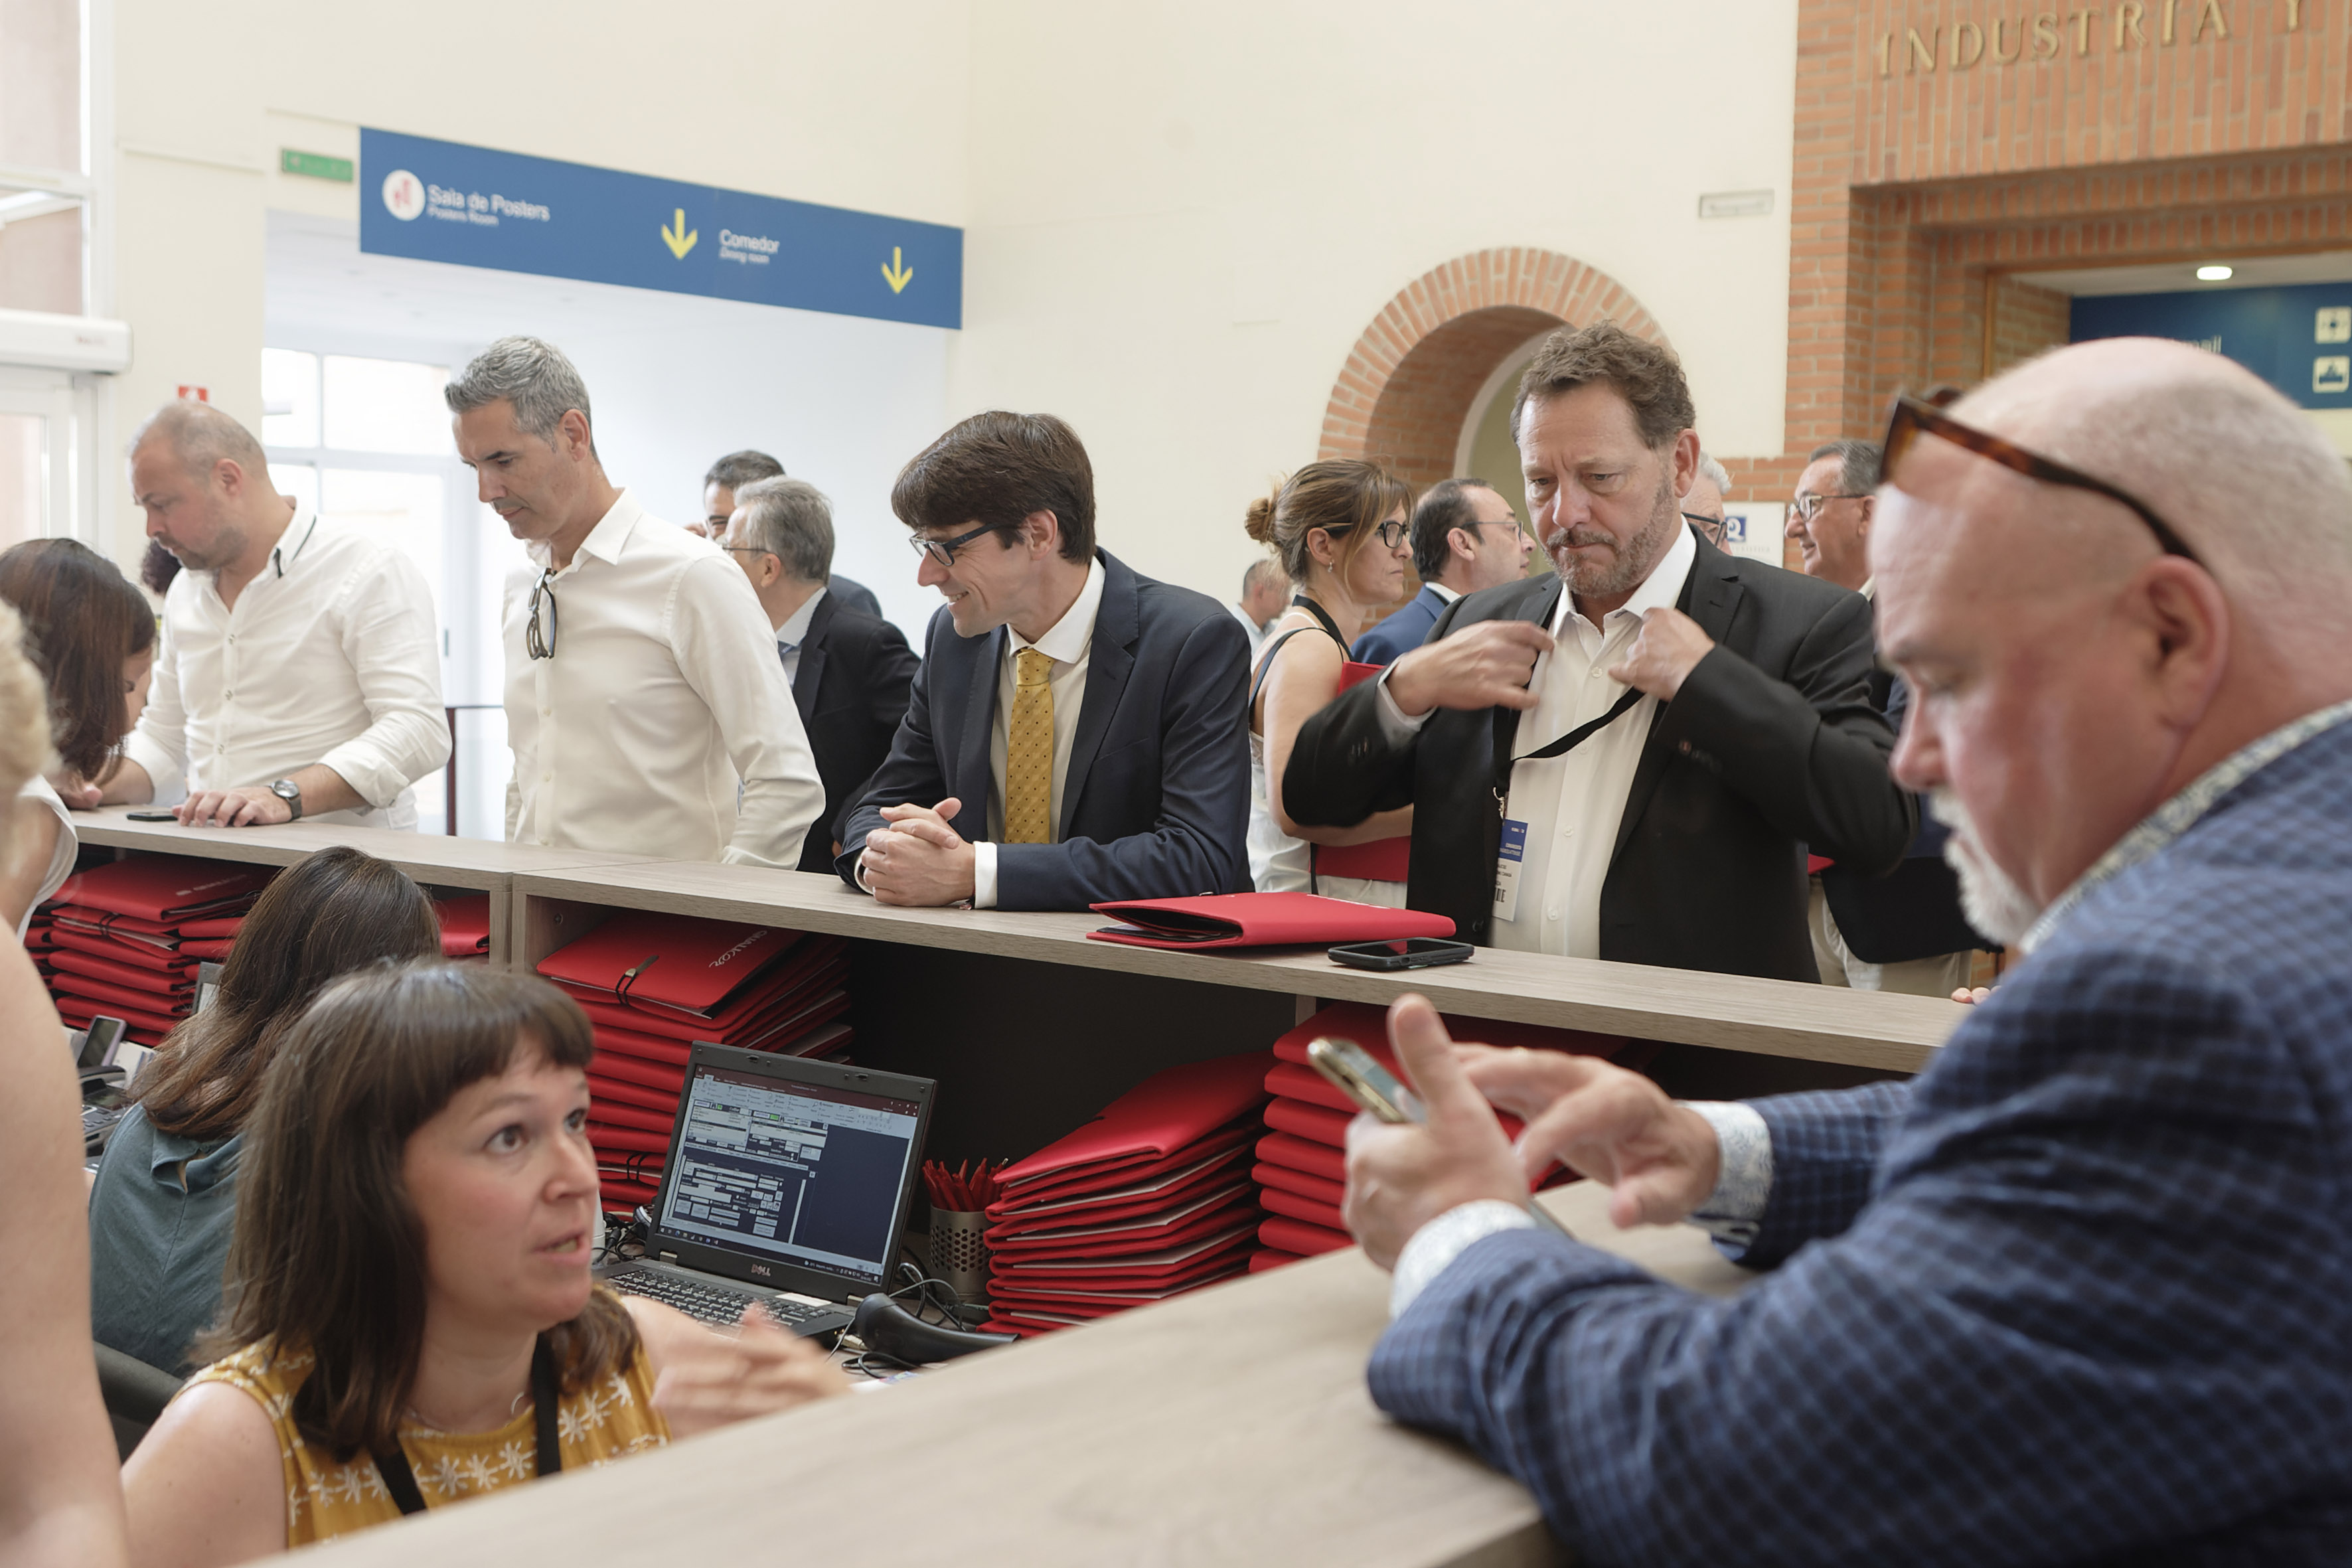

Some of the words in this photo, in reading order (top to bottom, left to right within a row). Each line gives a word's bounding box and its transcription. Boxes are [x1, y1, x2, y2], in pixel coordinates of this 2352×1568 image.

[1879, 0, 2227, 78] INDUSTRIA
[427, 184, 465, 209] Sala
[467, 191, 489, 213] de
[491, 194, 550, 222] Posters
[719, 228, 780, 254] Comedor
[751, 1263, 771, 1277] DELL
